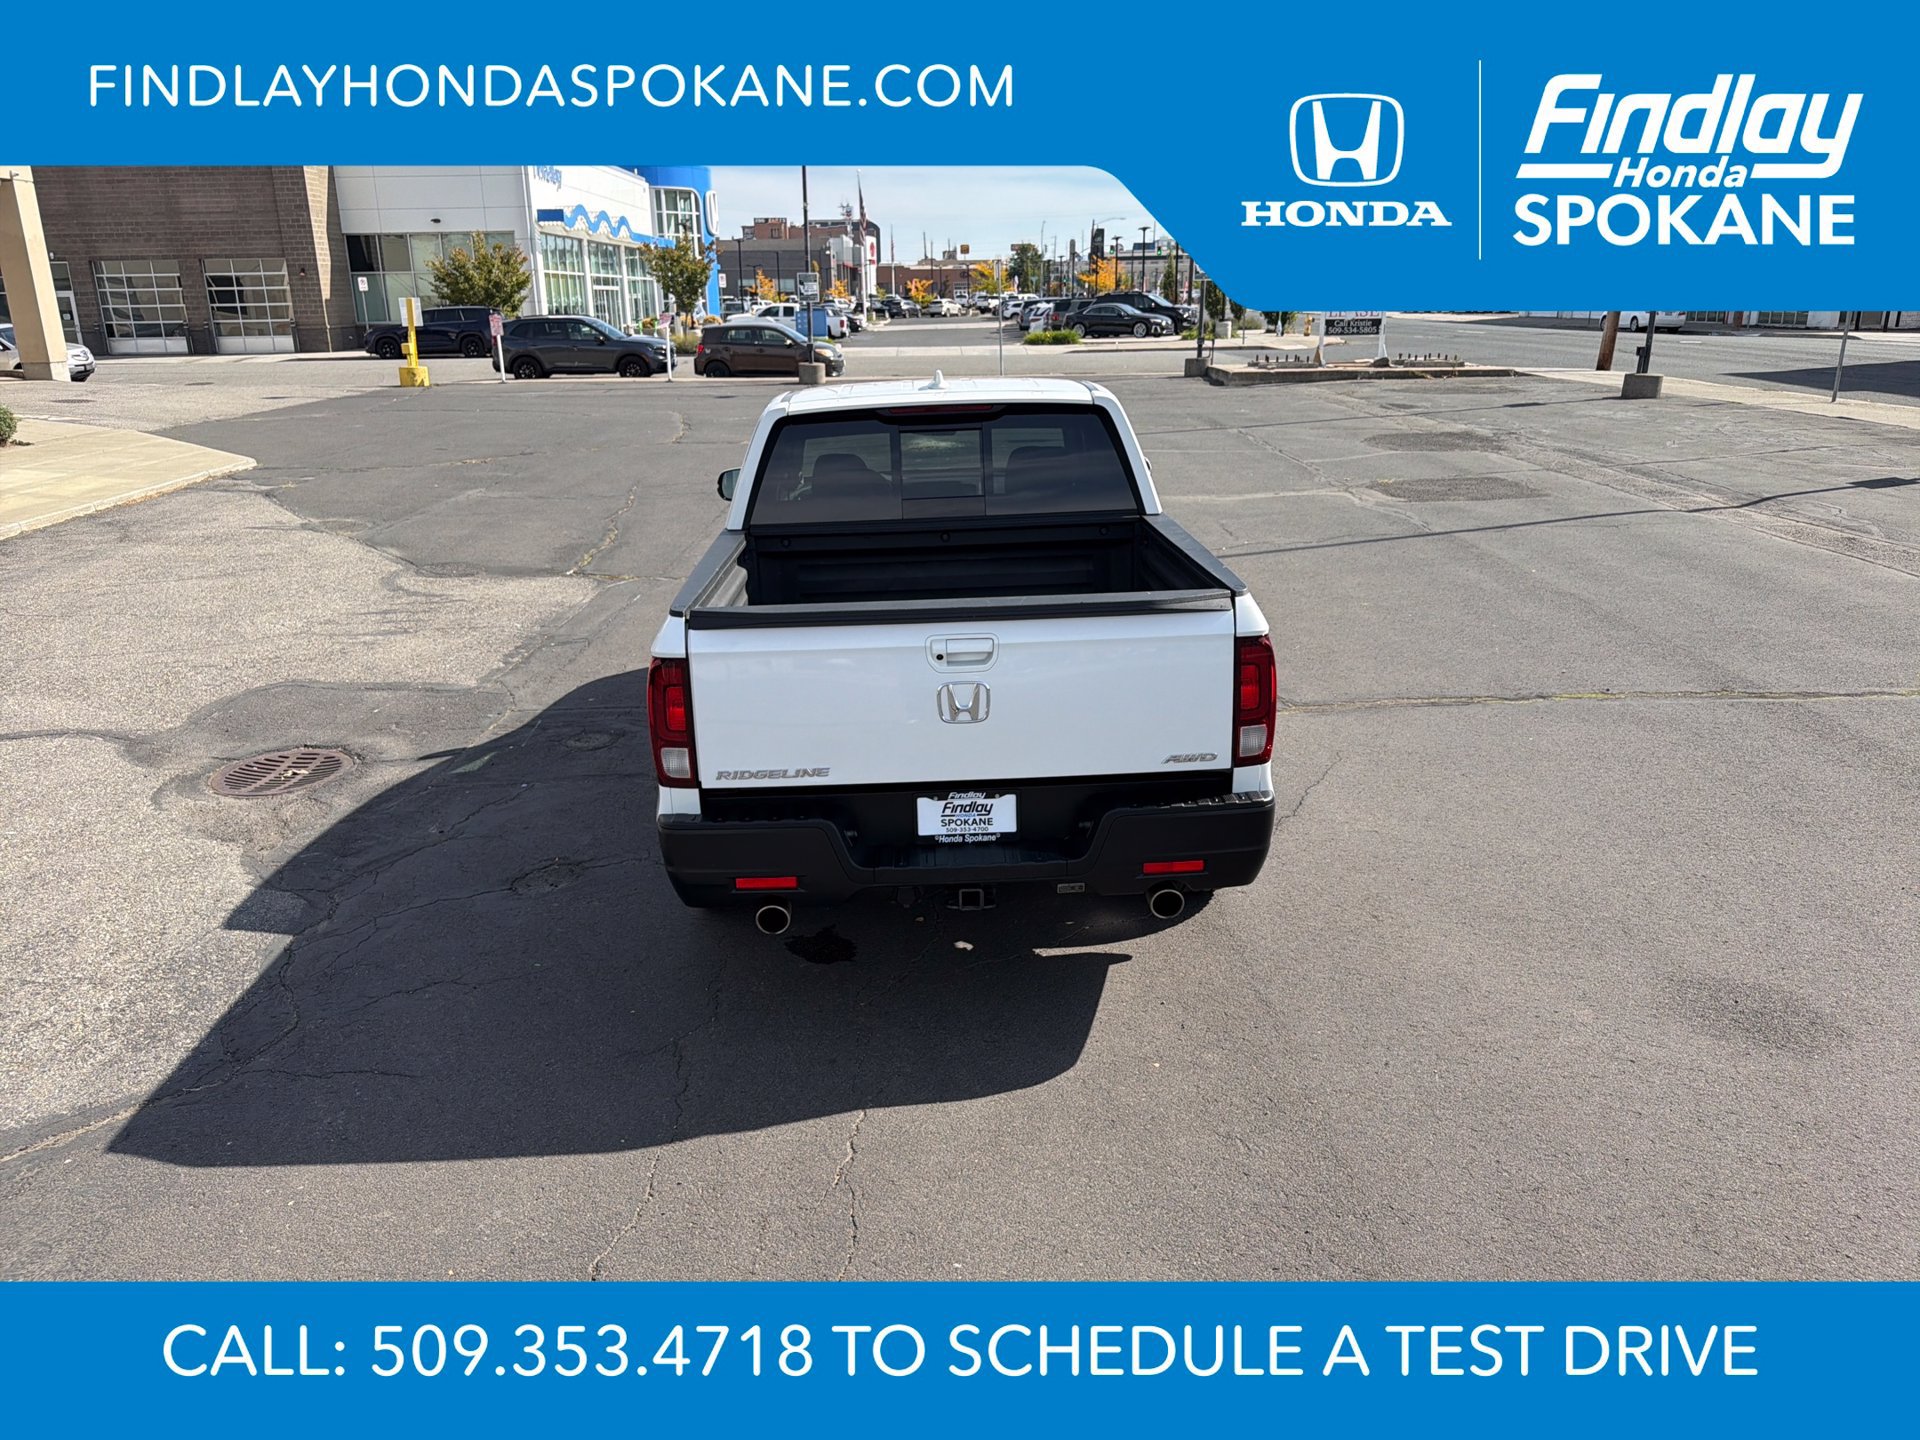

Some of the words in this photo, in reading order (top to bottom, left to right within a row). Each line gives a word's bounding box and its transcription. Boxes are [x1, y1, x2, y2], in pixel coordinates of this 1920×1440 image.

[1161, 751, 1218, 764] AWD
[716, 766, 831, 781] RIDGELINE
[947, 791, 987, 800] Findlay
[940, 800, 994, 817] Findlay
[940, 817, 994, 827] SPOKANE
[938, 834, 963, 843] Honda
[964, 833, 997, 844] Spokane
